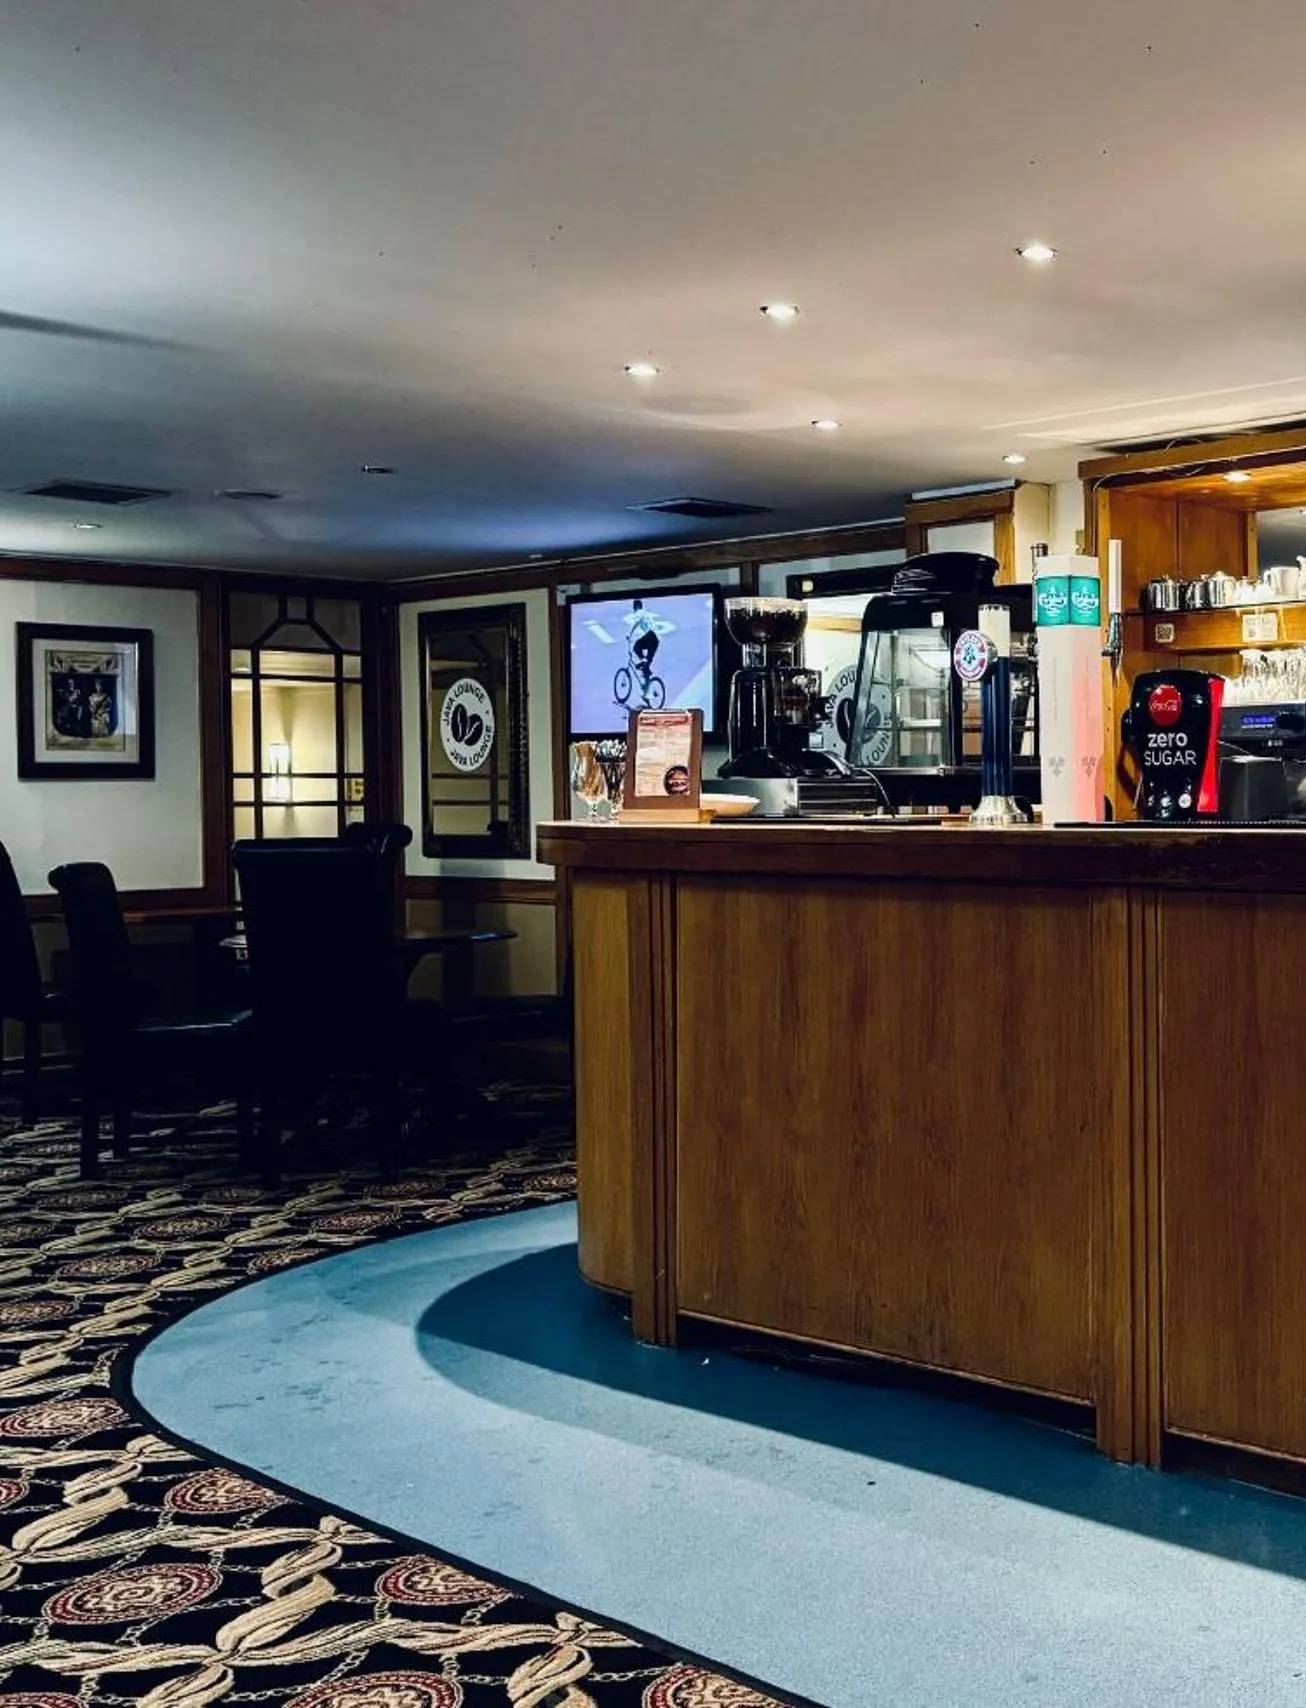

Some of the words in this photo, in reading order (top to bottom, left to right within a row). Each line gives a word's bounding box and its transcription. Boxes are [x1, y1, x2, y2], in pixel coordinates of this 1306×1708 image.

[453, 682, 485, 704] LOUNGE
[1147, 732, 1188, 747] zero
[1143, 750, 1197, 766] SUGAR
